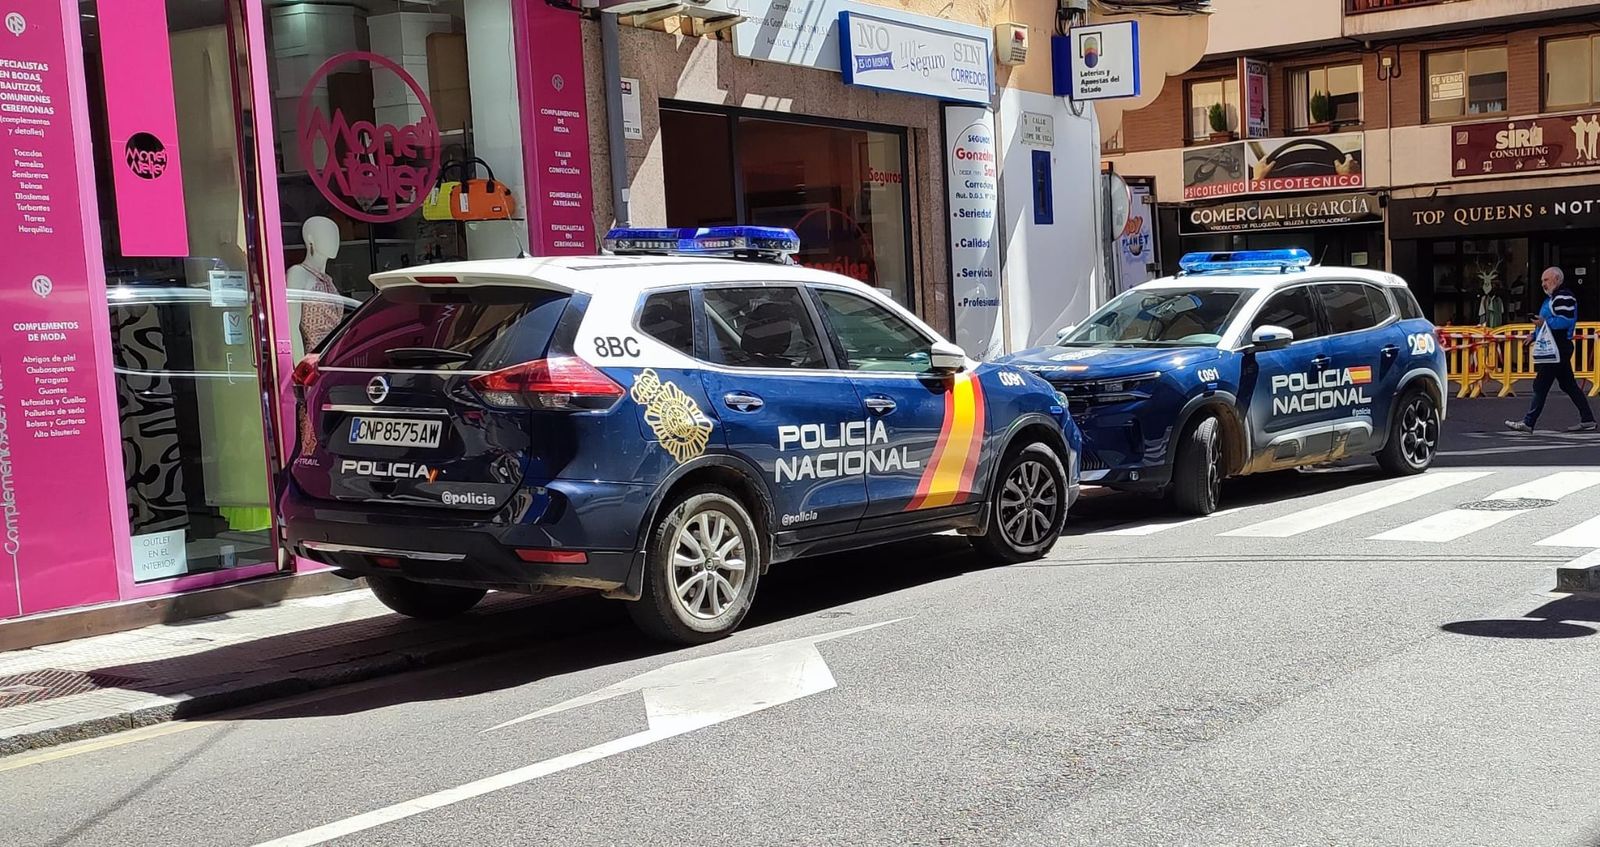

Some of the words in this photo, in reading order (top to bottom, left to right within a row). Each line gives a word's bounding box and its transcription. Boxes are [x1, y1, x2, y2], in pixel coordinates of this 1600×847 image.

[857, 23, 890, 51] NO
[900, 40, 916, 60] un
[953, 42, 982, 65] SIN
[858, 60, 864, 69] ES
[865, 59, 871, 68] LO
[872, 57, 890, 68] MISMO
[910, 54, 946, 77] seguro
[12, 71, 42, 82] BODAS,
[951, 67, 987, 87] CORREDOR
[0, 82, 43, 93] BAUTIZOS,
[1081, 86, 1102, 94] Estado
[1, 104, 54, 114] CEREMONIAS
[302, 107, 435, 160] Monet
[1490, 146, 1549, 159] CONSULTING
[869, 167, 902, 186] Seguros
[1251, 173, 1361, 192] PSICOTECNICO
[1184, 181, 1246, 199] PSICOTECNICO
[1190, 204, 1285, 225] COMERCIAL
[1413, 210, 1445, 226] TOP
[1454, 203, 1533, 226] QUEENS
[1540, 207, 1547, 215] &
[13, 321, 79, 331] COMPLEMENTOS
[41, 333, 67, 341] MODA
[593, 336, 641, 358] 8BC
[63, 354, 76, 363] piel
[1273, 386, 1372, 416] NACIONAL
[57, 407, 66, 415] de
[778, 417, 888, 451] POLICÍA
[775, 447, 920, 483] NACIONAL
[441, 490, 496, 506] @policia
[782, 511, 818, 527] @policia
[143, 536, 170, 547] OUTLET
[149, 550, 158, 558] EN
